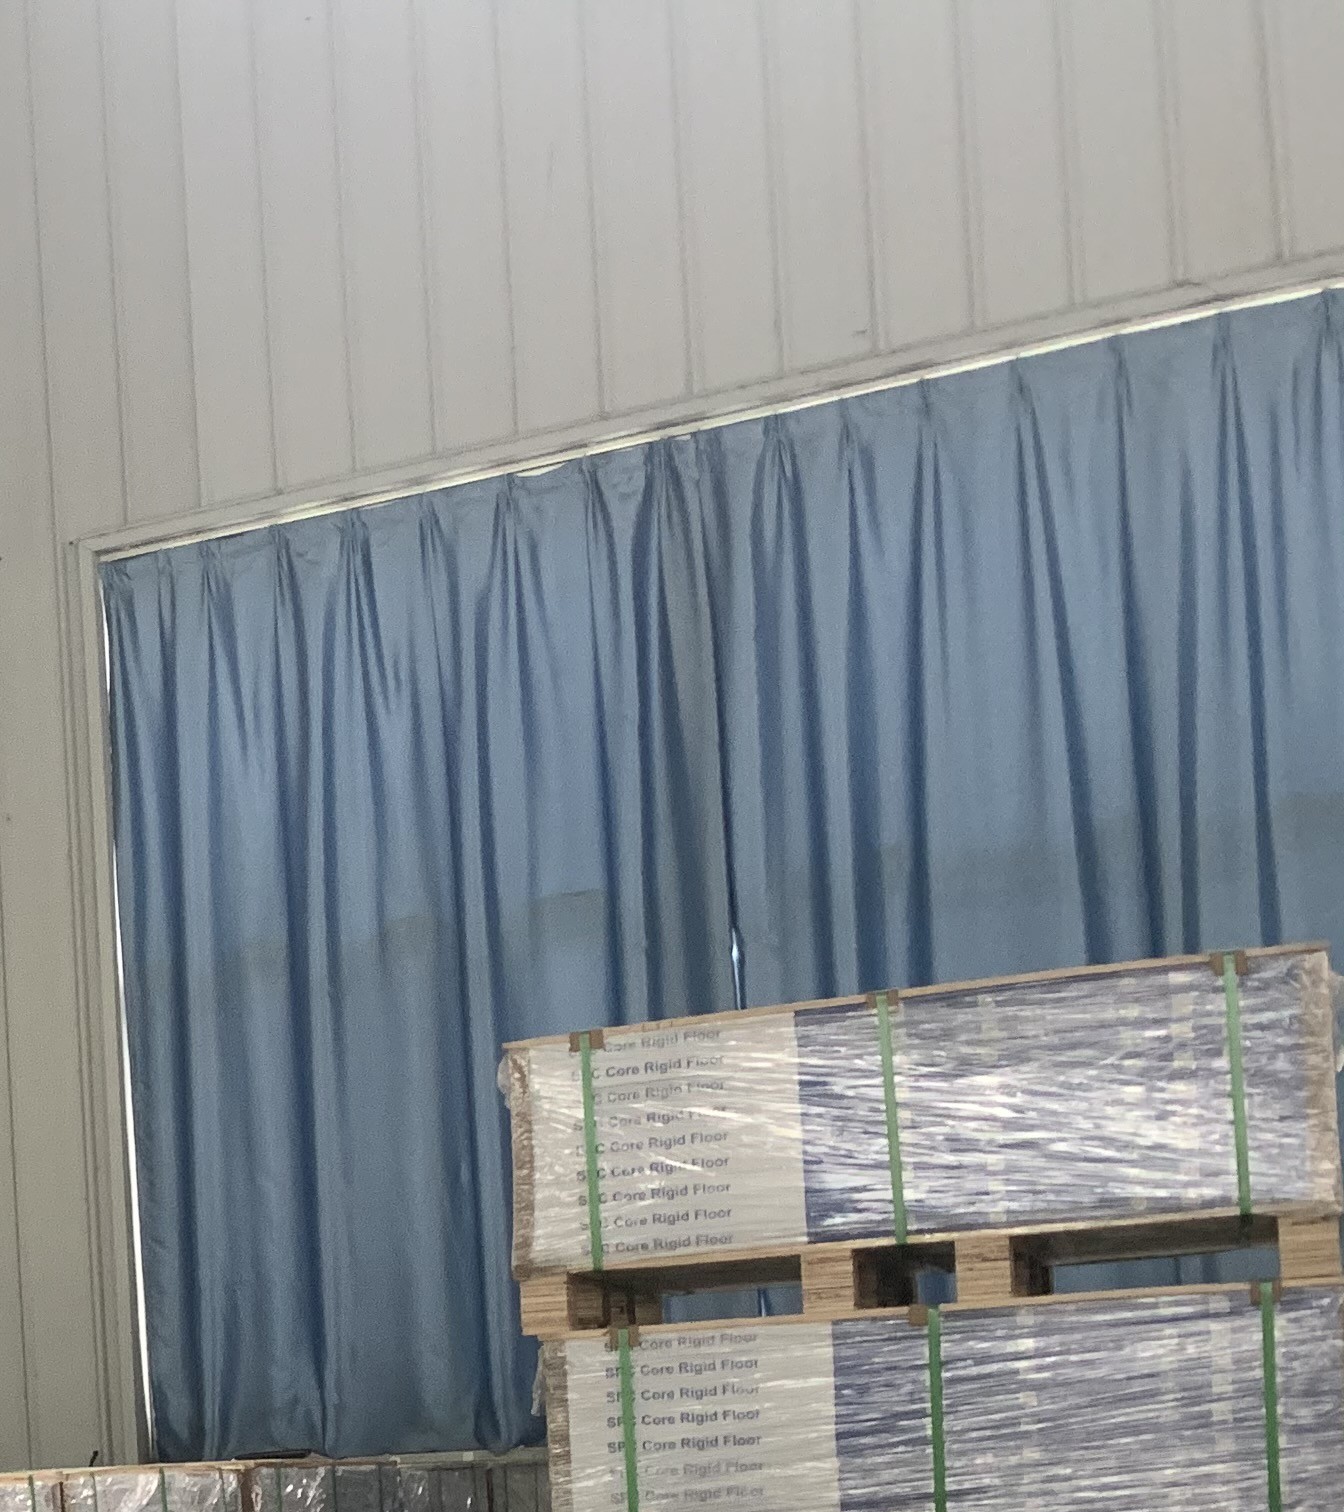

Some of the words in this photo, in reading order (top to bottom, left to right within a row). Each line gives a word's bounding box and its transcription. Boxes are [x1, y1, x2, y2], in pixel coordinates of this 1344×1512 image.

[611, 1140, 643, 1152] Core
[649, 1134, 685, 1150] Rigid
[691, 1131, 728, 1145] Floor
[578, 1193, 607, 1206] SC
[651, 1185, 688, 1200] Rigid
[693, 1183, 731, 1194] Floor
[696, 1234, 733, 1246] Floor
[640, 1364, 674, 1377] Core
[679, 1361, 716, 1375] Rigid
[721, 1359, 759, 1369] Floor
[641, 1414, 676, 1426] Core
[680, 1412, 718, 1426] Rigid
[722, 1409, 759, 1420] Floor
[643, 1440, 676, 1451] Core
[681, 1438, 719, 1451] Rigid
[724, 1436, 762, 1446] Floor
